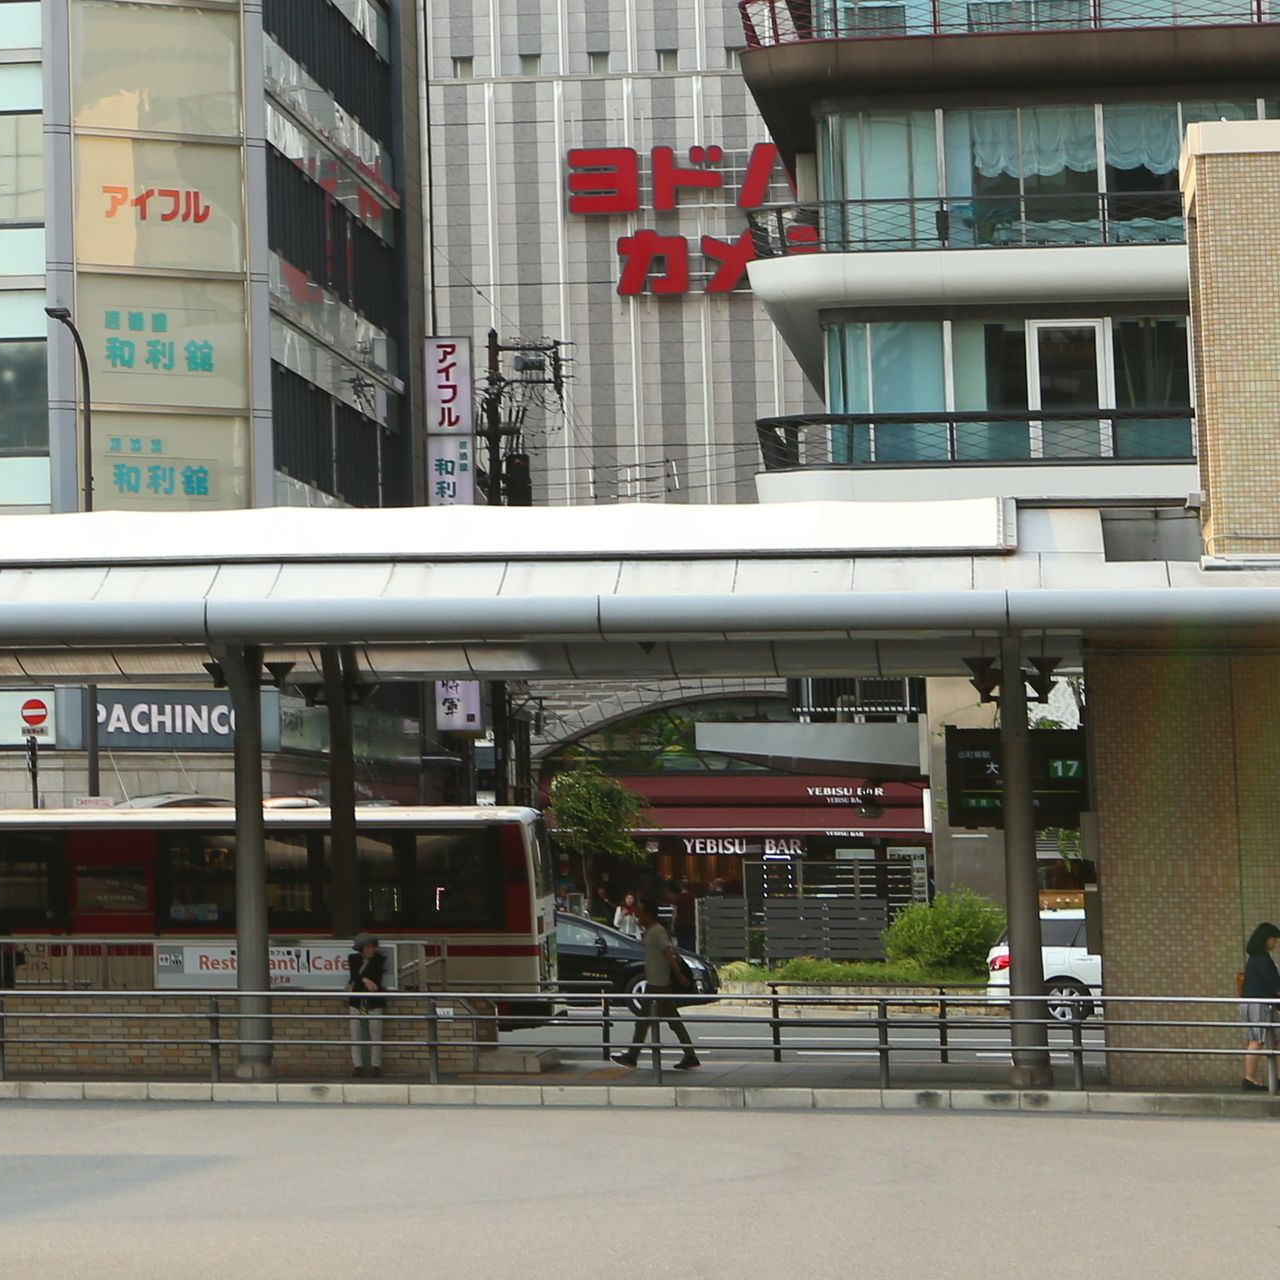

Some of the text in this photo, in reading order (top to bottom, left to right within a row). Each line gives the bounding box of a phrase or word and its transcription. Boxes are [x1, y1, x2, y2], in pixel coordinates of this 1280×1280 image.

[102, 185, 210, 223] アイフル
[436, 344, 460, 427] アイフル
[435, 458, 457, 505] 和利
[96, 703, 236, 735] ACHINC
[1053, 761, 1079, 776] 17
[806, 787, 853, 796] YEBISU
[683, 838, 803, 854] YEBISU BAR
[199, 954, 296, 971] Restant
[311, 955, 350, 971] Cafe
